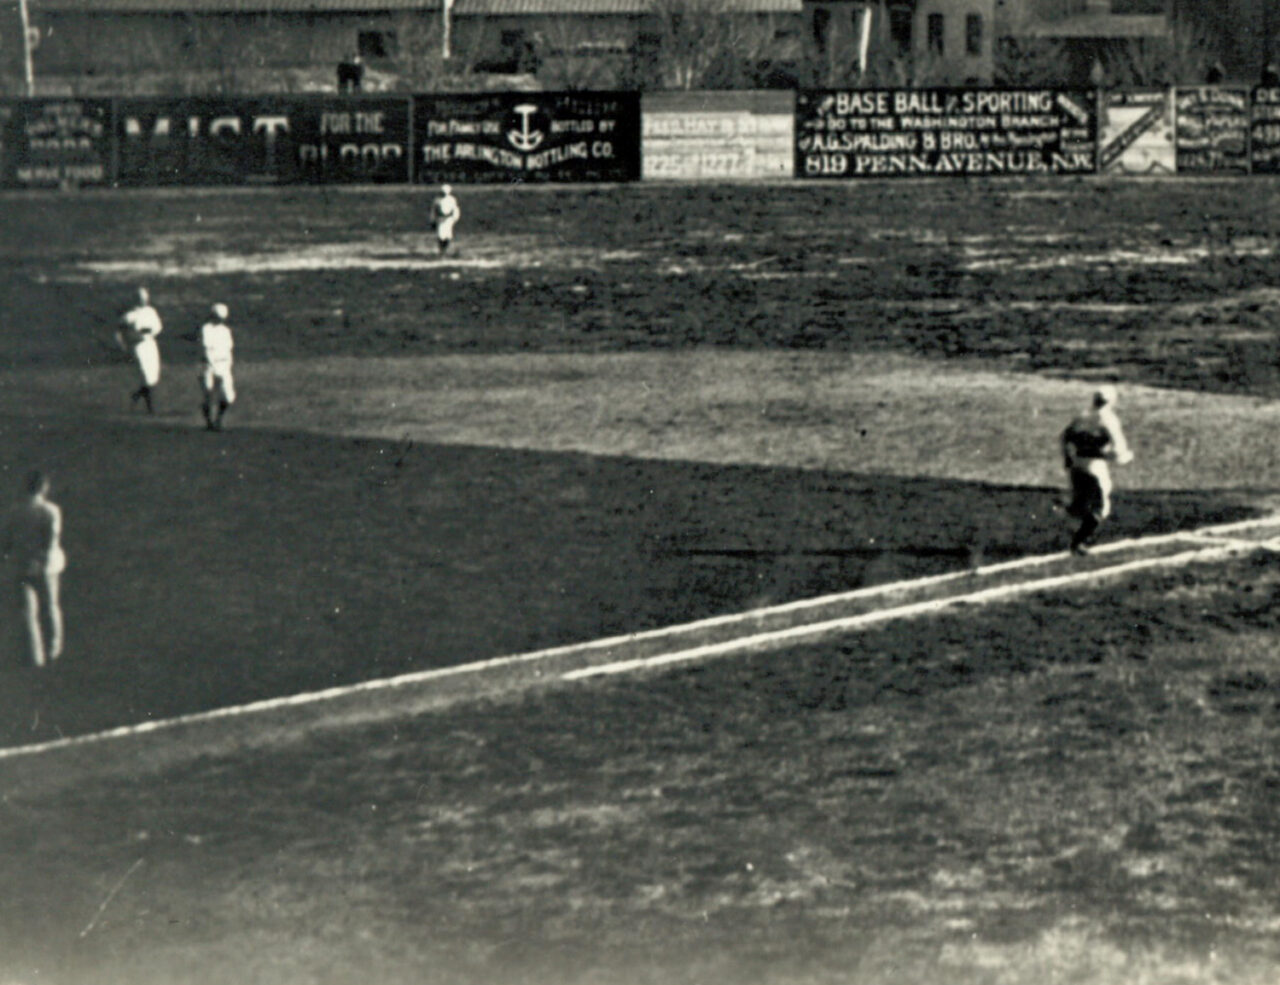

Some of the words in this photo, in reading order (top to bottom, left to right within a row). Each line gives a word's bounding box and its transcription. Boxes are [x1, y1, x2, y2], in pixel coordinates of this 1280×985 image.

[836, 91, 889, 114] BASE
[894, 91, 943, 114] BALL
[962, 90, 1053, 113] SPORTING
[321, 112, 350, 135] FOR
[355, 111, 386, 134] THE
[598, 119, 617, 133] BY
[850, 117, 867, 130] TO
[870, 117, 895, 129] THE
[900, 116, 996, 130] WASHINGTON
[1001, 114, 1060, 129] BRANCH
[922, 131, 936, 150] &
[422, 143, 450, 163] THE
[453, 142, 524, 169] ARLINGTON
[526, 141, 588, 171] BOTTLING
[805, 154, 848, 174] 819
